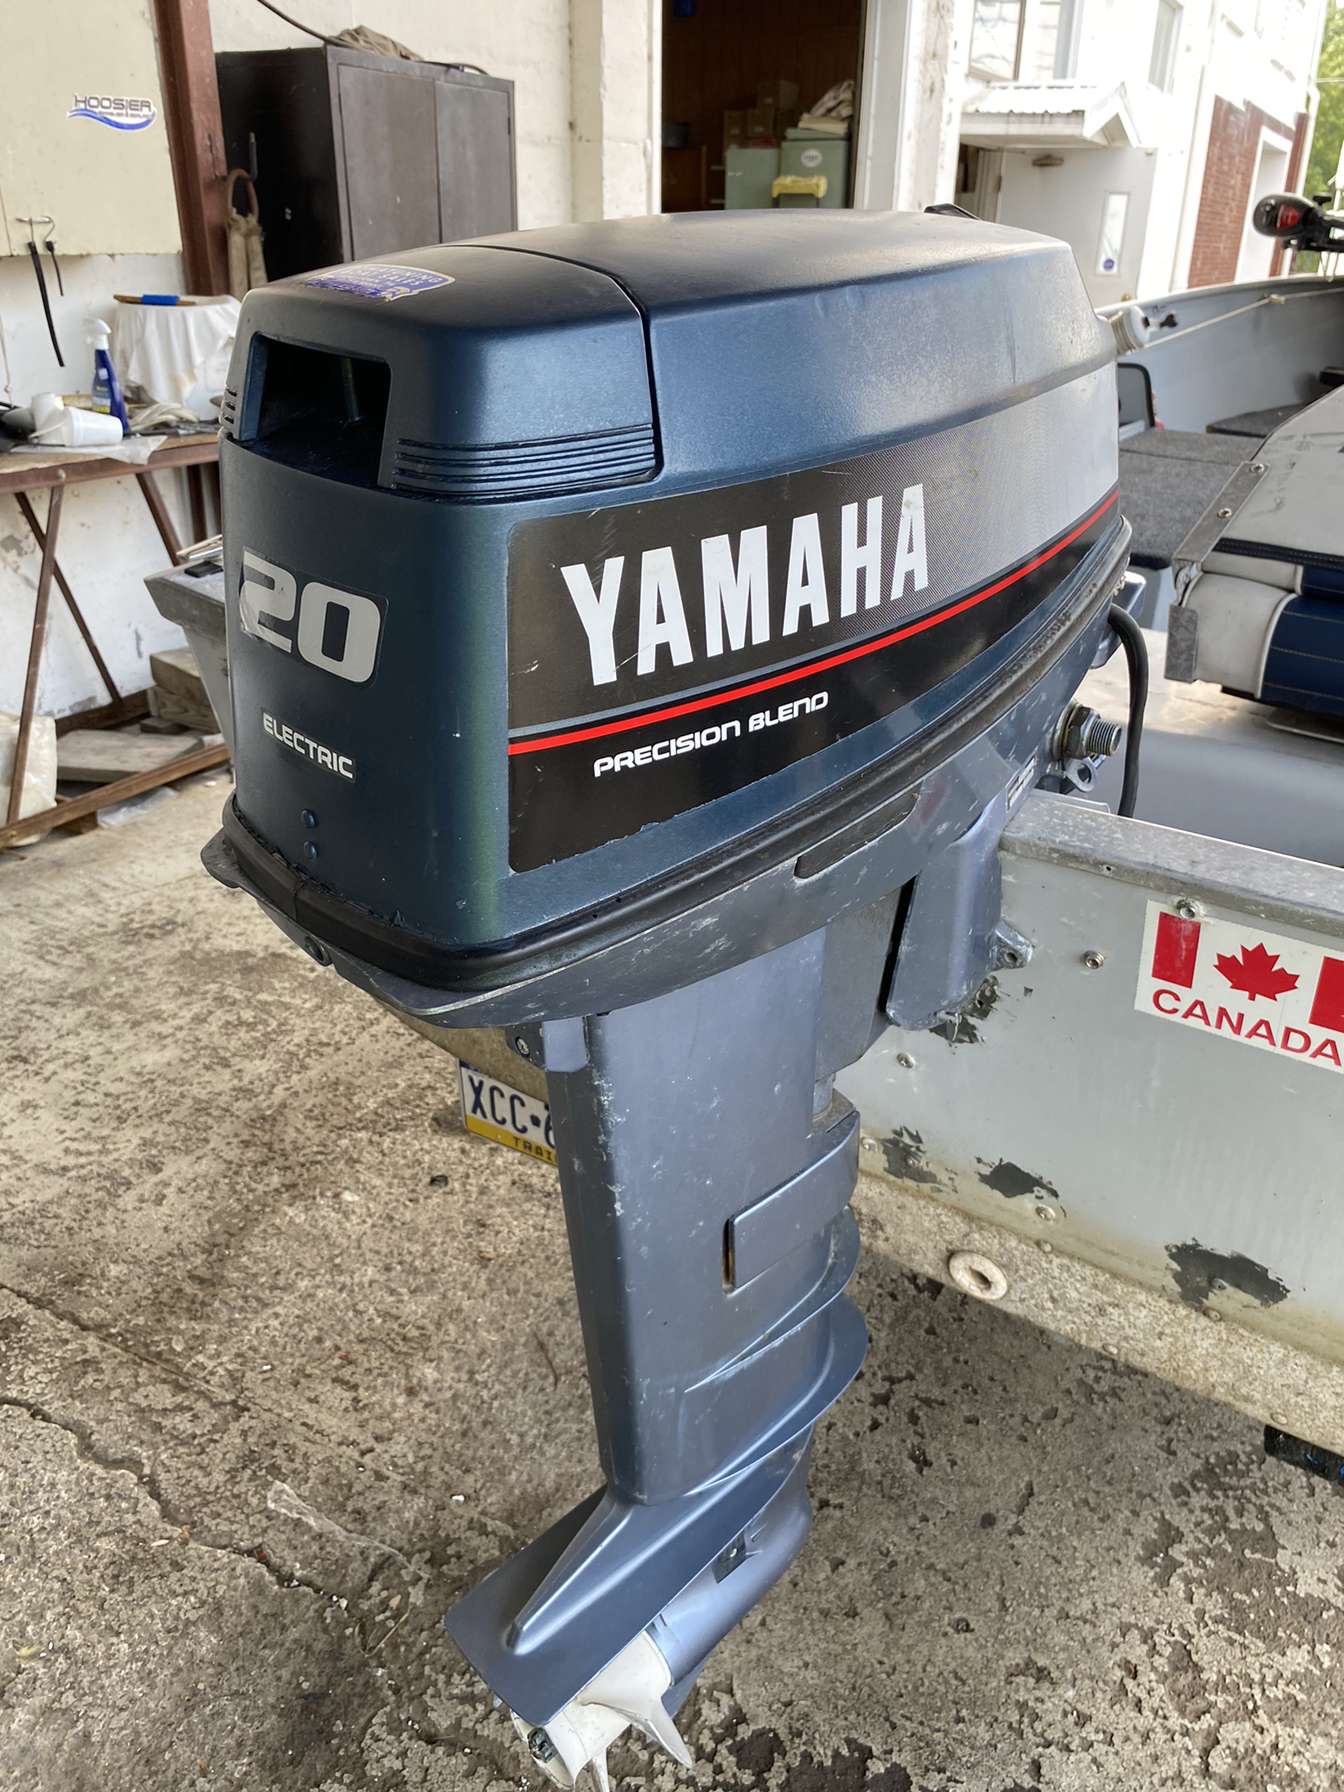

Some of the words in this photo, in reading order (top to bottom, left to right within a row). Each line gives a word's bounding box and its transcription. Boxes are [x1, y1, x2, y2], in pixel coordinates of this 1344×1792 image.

[74, 95, 152, 112] HOOSIER
[239, 551, 382, 682] 20
[560, 483, 928, 686] YAMAHA
[263, 712, 354, 779] ELECTRIC
[593, 720, 741, 778] PRECISION
[748, 691, 829, 734] BLEND
[1152, 988, 1342, 1067] CANADA
